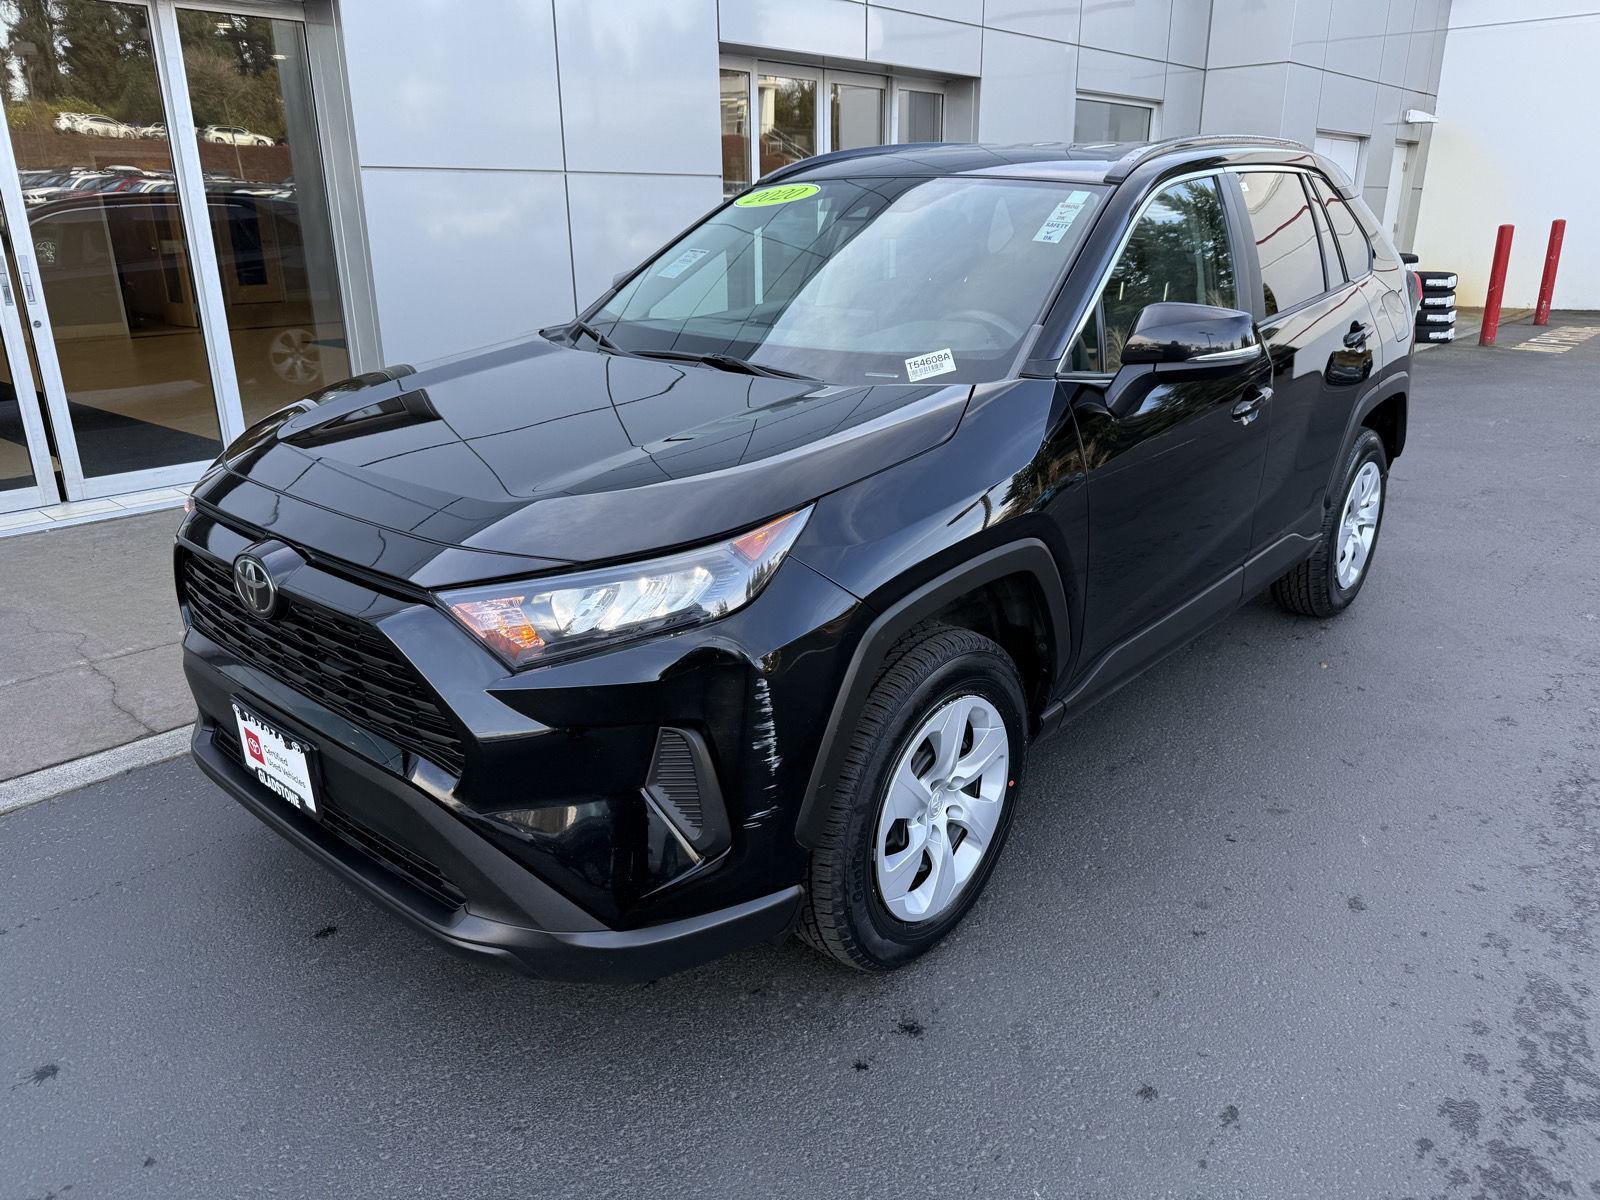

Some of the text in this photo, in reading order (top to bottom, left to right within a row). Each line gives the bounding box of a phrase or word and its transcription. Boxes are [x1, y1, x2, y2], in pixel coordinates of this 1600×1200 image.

[743, 187, 809, 204] 2020
[907, 352, 951, 370] T54608A
[244, 711, 284, 743] TOYOTA
[257, 769, 301, 809] GLADSTONE
